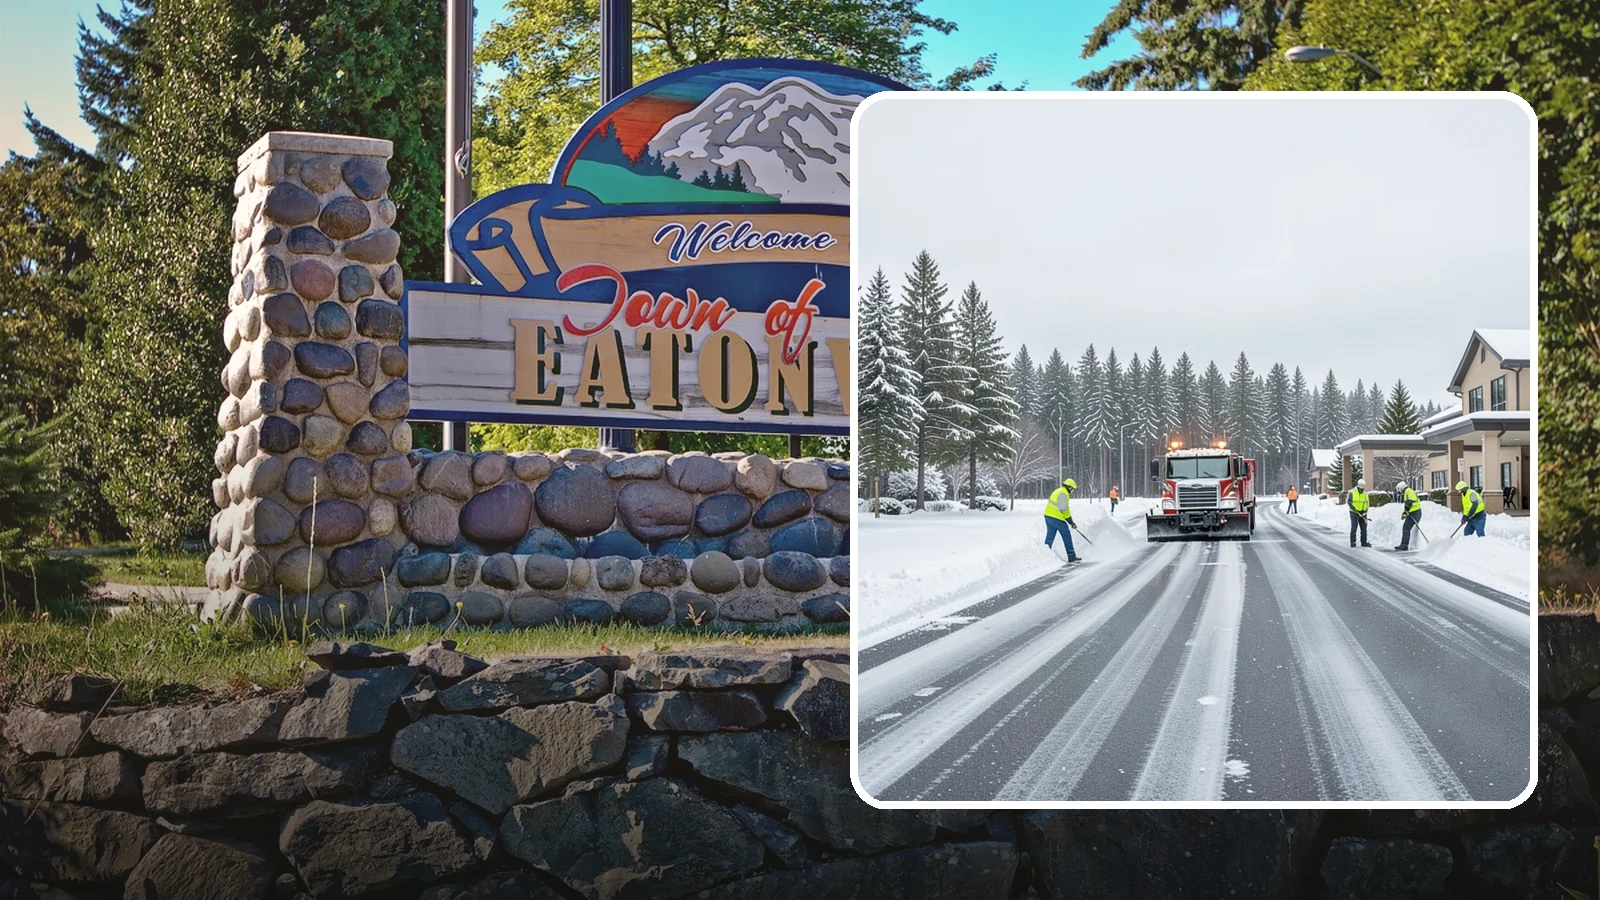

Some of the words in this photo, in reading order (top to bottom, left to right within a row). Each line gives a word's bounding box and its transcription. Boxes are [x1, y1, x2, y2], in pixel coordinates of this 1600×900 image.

[653, 221, 837, 263] Welcome
[557, 263, 736, 335] Town
[765, 279, 825, 365] of
